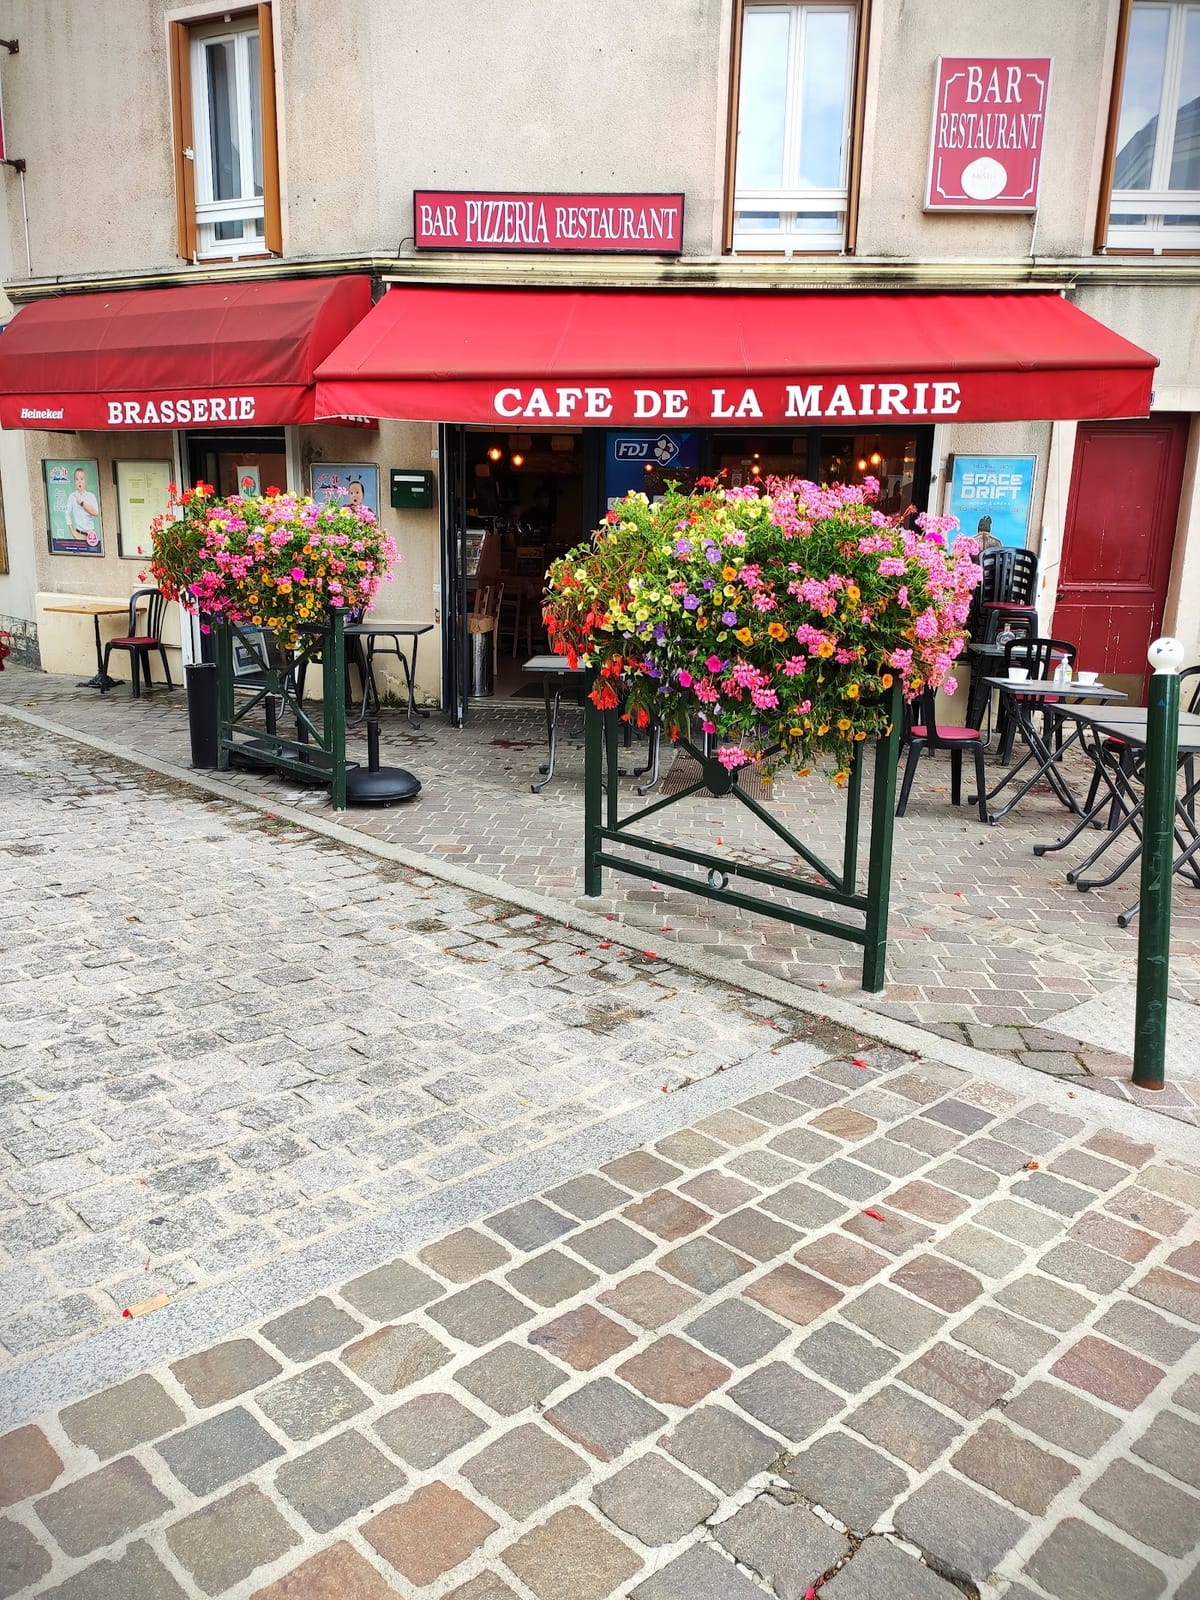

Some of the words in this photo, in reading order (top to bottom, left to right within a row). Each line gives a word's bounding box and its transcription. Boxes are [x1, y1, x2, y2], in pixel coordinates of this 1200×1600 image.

[965, 66, 1022, 103] BAR
[938, 112, 1042, 150] RESTAURANT
[420, 205, 458, 236] BAR
[464, 200, 550, 244] PIZZERIA
[555, 207, 677, 240] RESTAURANT
[20, 408, 64, 420] Heineken
[107, 396, 256, 425] BRASSERIE
[494, 387, 613, 418] CAFE
[633, 389, 689, 418] DE
[711, 388, 763, 418] LA
[785, 382, 961, 417] MAIRIE
[618, 443, 649, 457] FDJ
[961, 486, 1021, 499] DRIFT
[962, 474, 1023, 485] SPACE
